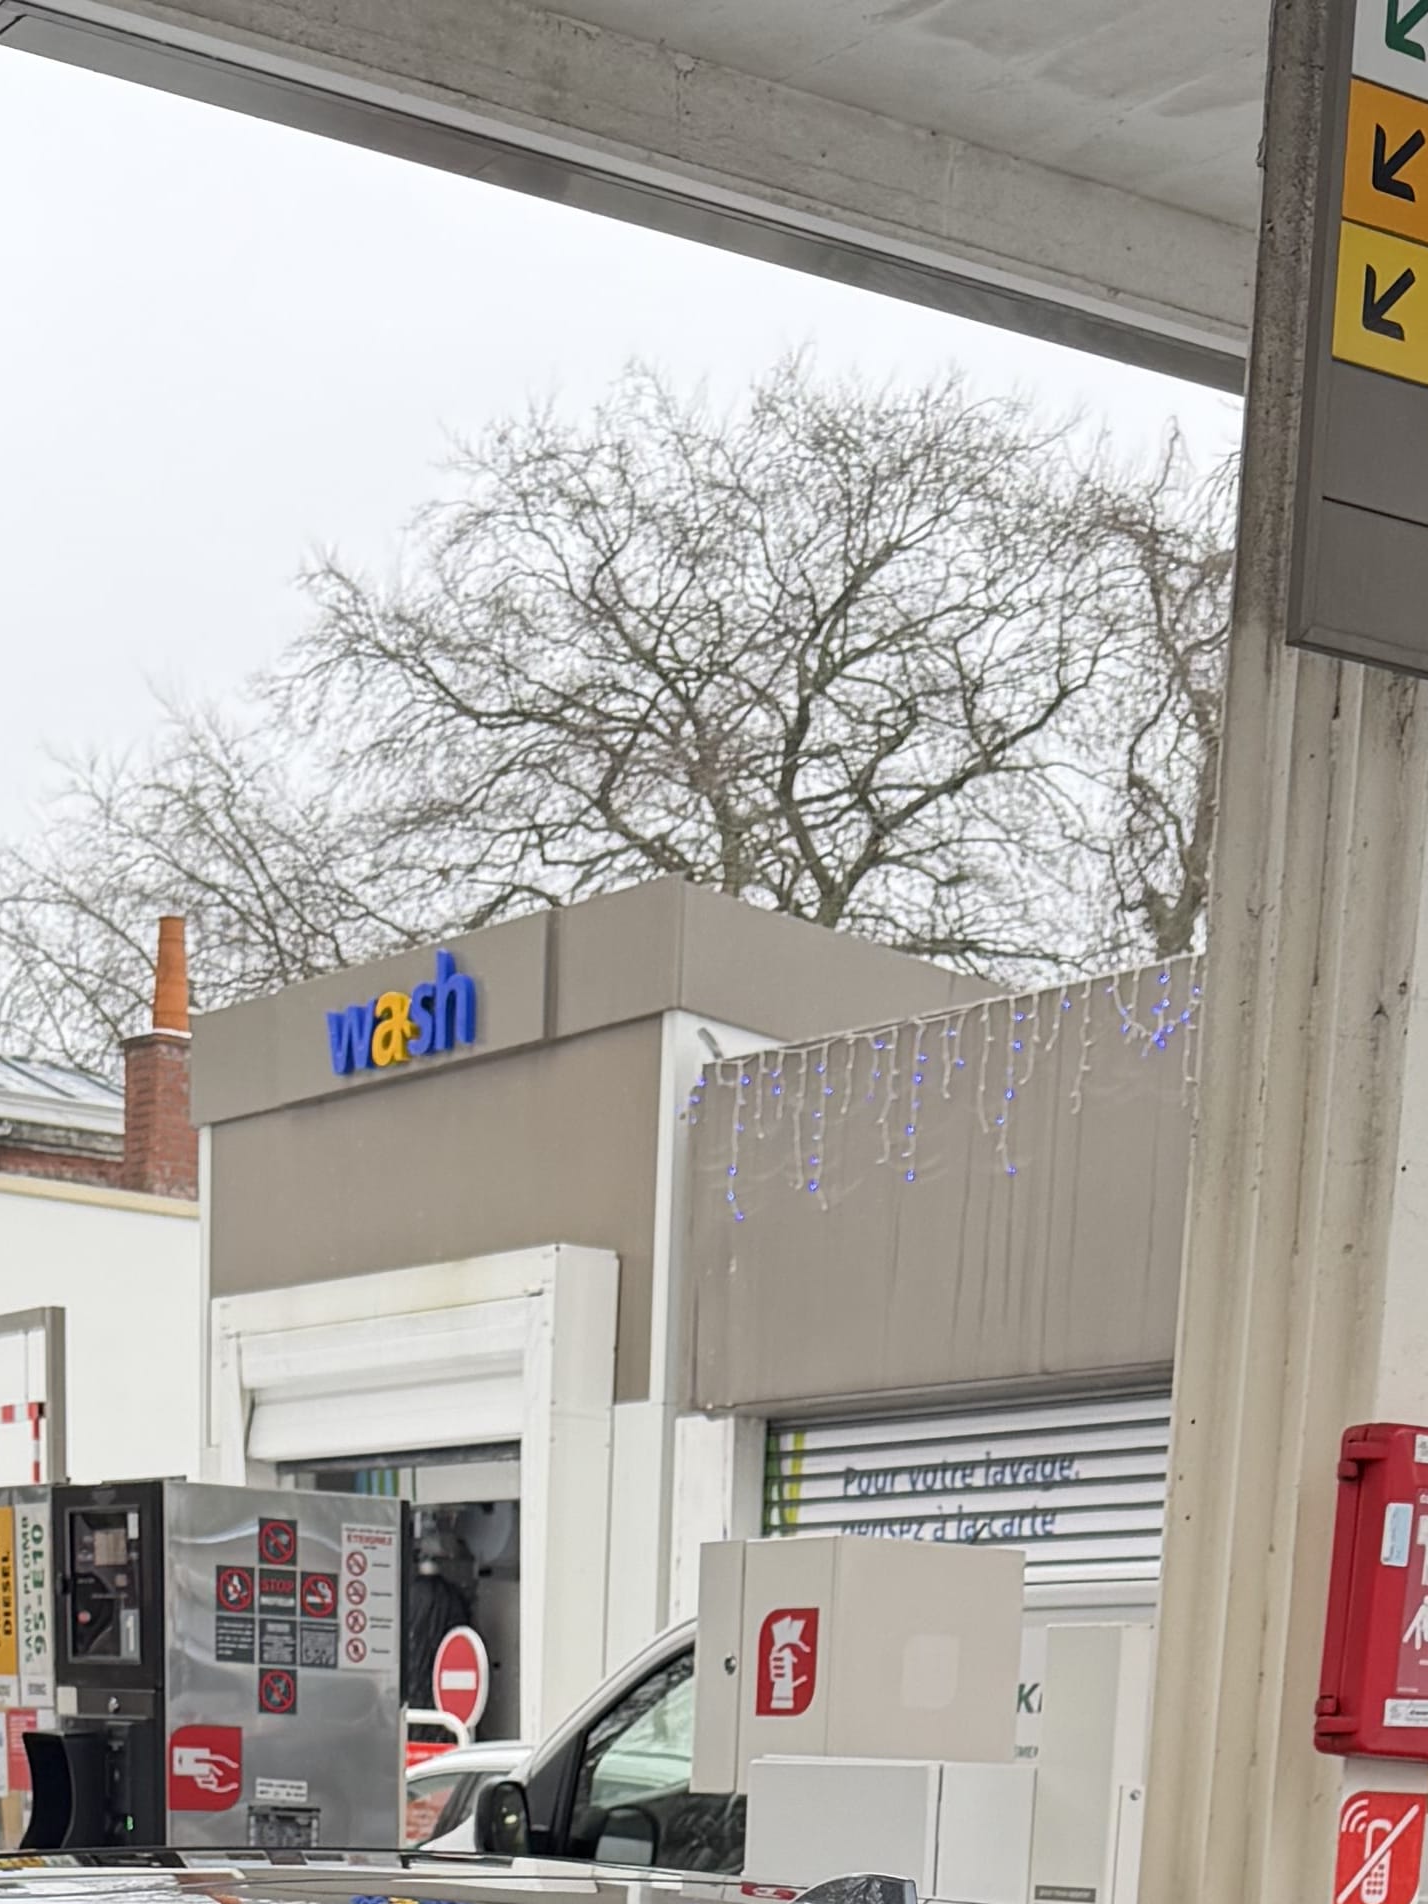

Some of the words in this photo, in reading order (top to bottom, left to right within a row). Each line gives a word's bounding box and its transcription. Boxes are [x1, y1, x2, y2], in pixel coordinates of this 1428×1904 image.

[326, 947, 478, 1077] wash
[842, 1464, 898, 1497] Pour
[907, 1459, 976, 1492] votre
[1, 1550, 13, 1637] DIESEL
[31, 1523, 47, 1656] 95-E10
